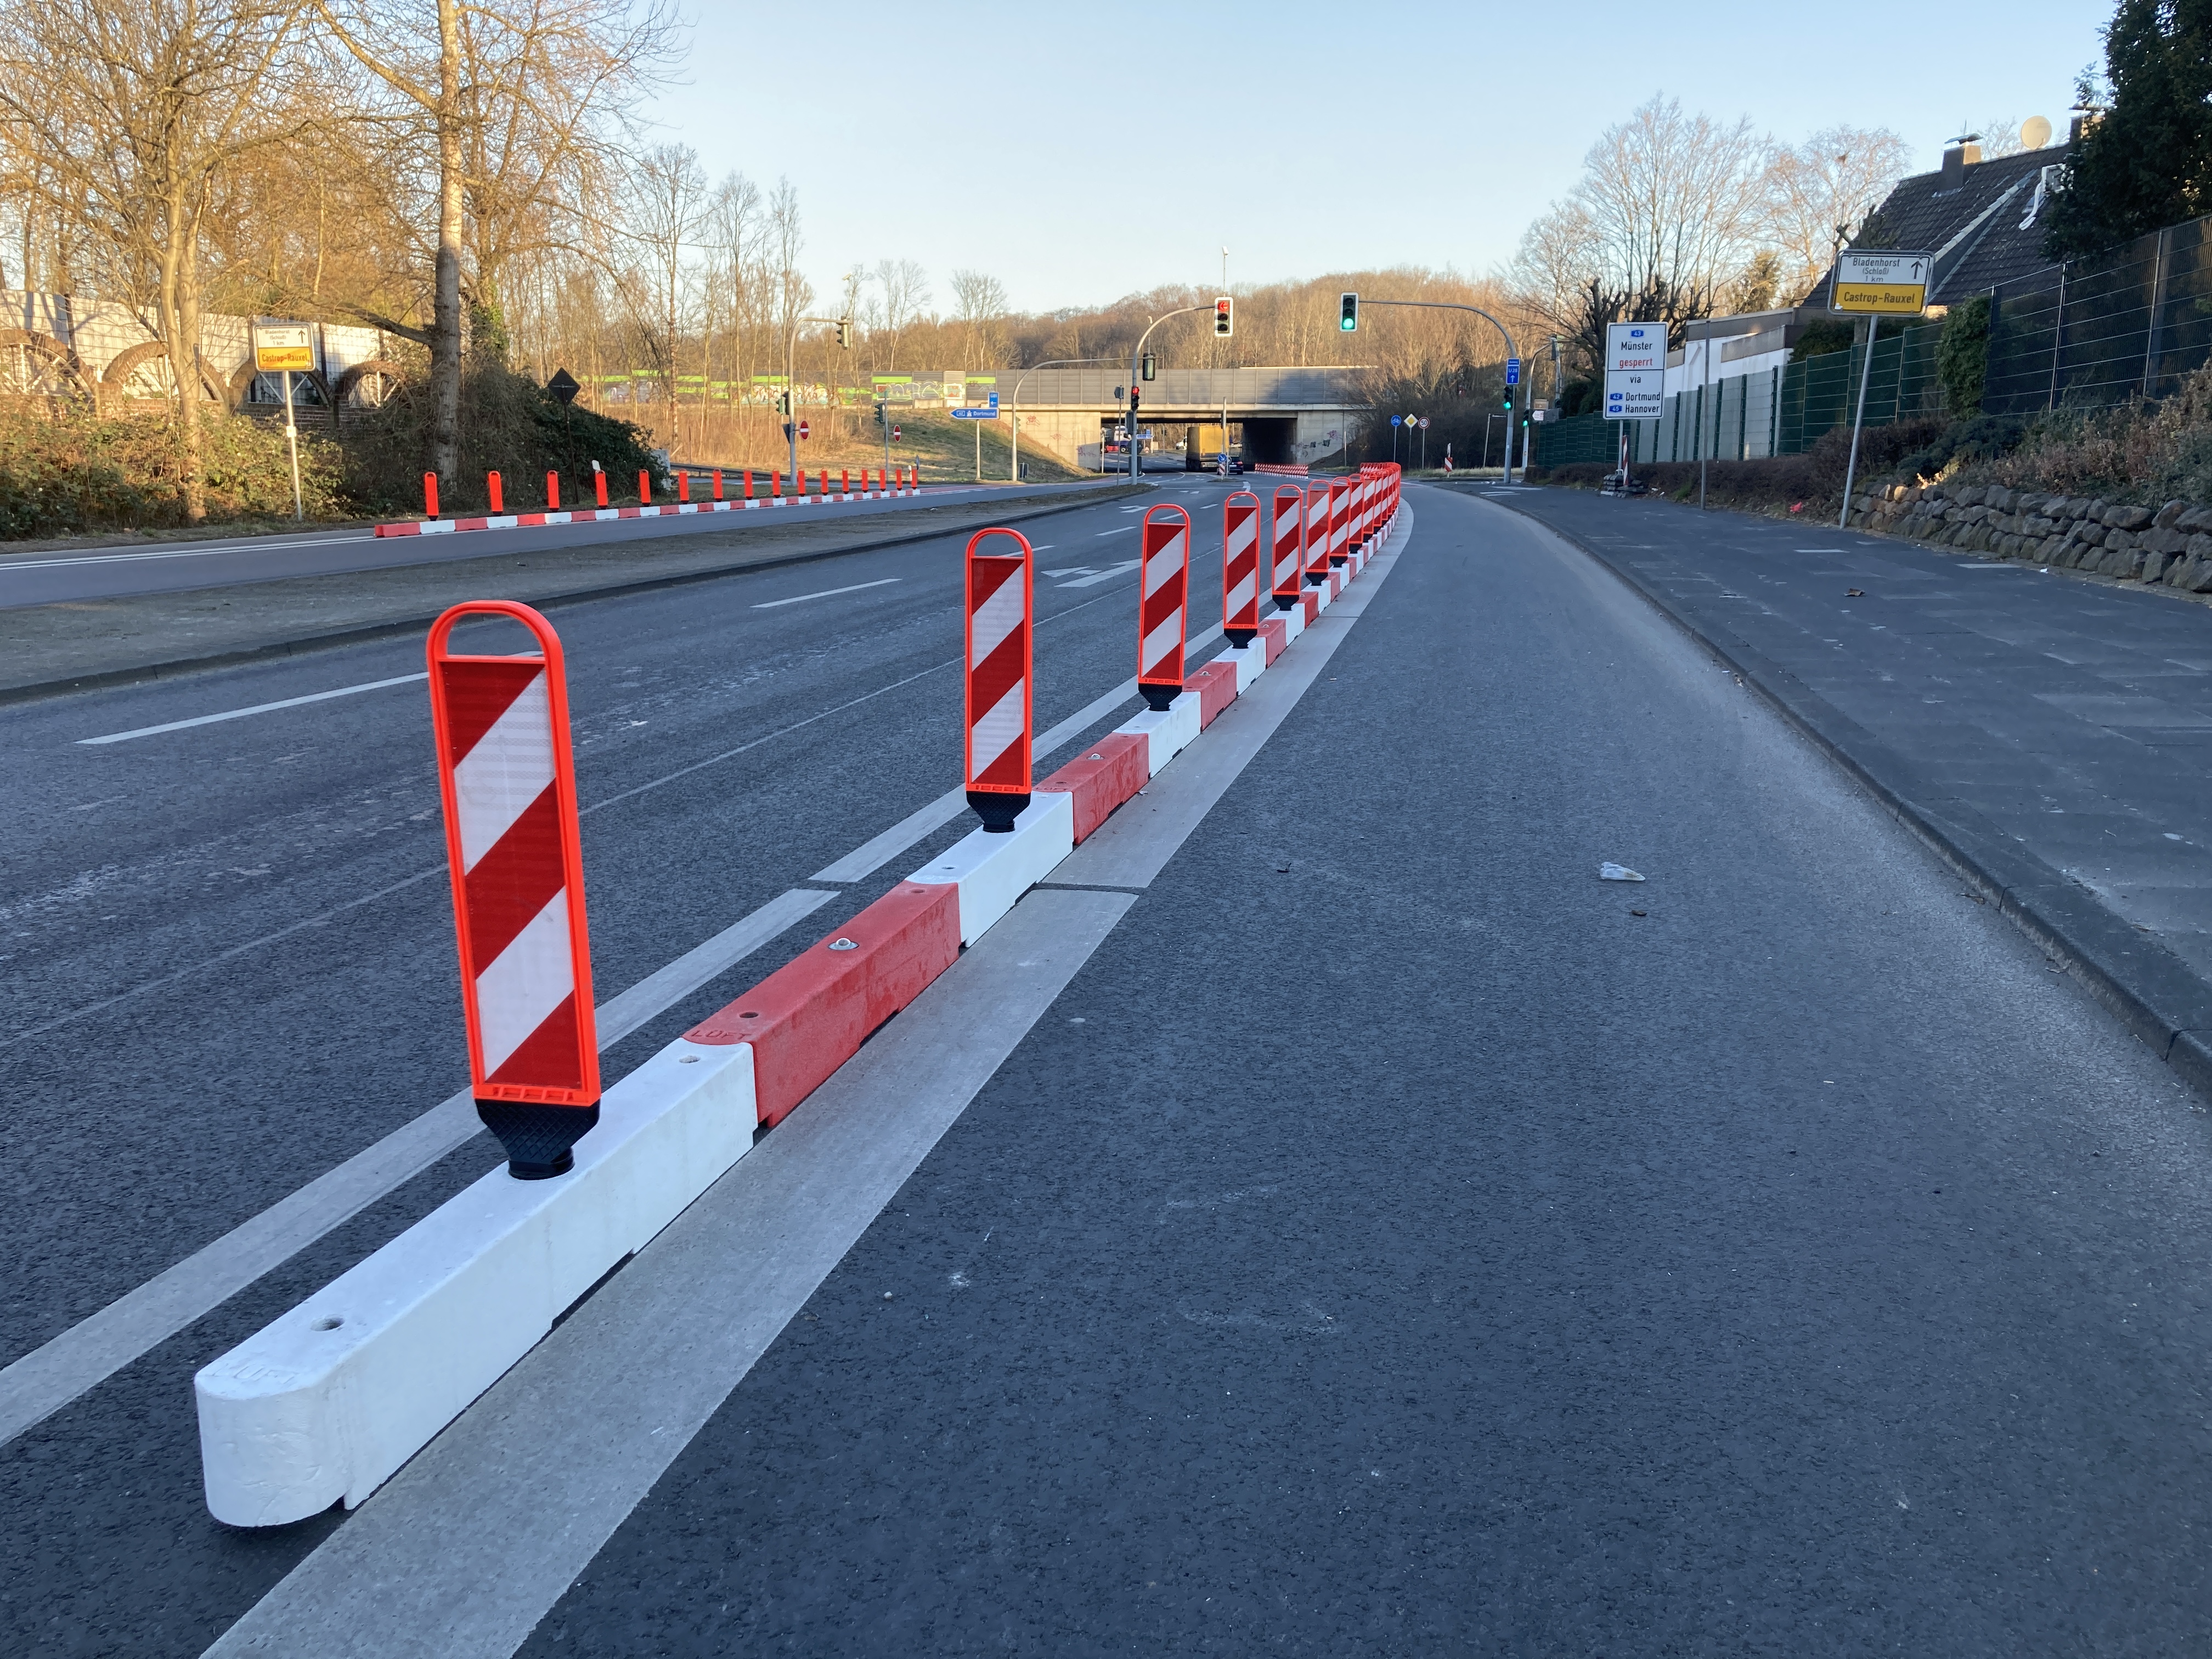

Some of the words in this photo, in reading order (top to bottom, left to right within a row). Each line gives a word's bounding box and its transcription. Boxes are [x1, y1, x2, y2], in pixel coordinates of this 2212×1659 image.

[1853, 257, 1900, 267] Bladenhorst
[1844, 292, 1915, 304] Castrop-Rauxel
[1621, 341, 1653, 351] Münster
[262, 353, 308, 363] Castrop-Rauxel
[1620, 358, 1653, 369] gesperrt
[1630, 374, 1641, 383] via
[1626, 392, 1661, 401] Dortmund
[1625, 404, 1660, 413] Hannover
